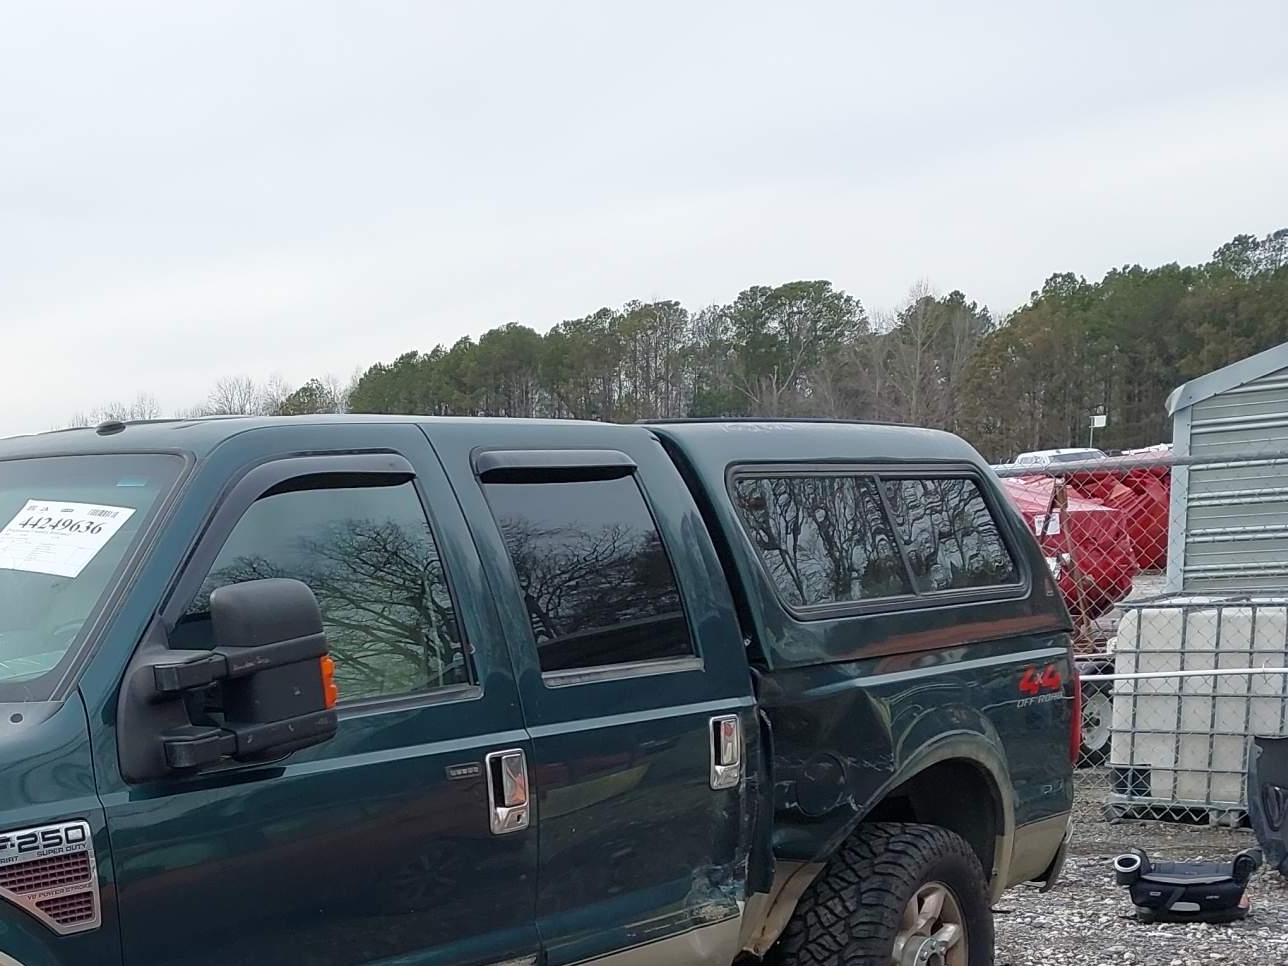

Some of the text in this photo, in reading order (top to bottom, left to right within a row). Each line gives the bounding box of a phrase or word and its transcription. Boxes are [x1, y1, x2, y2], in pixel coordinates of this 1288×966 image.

[19, 515, 106, 535] 44249636
[37, 843, 87, 857] SUPER DUTY
